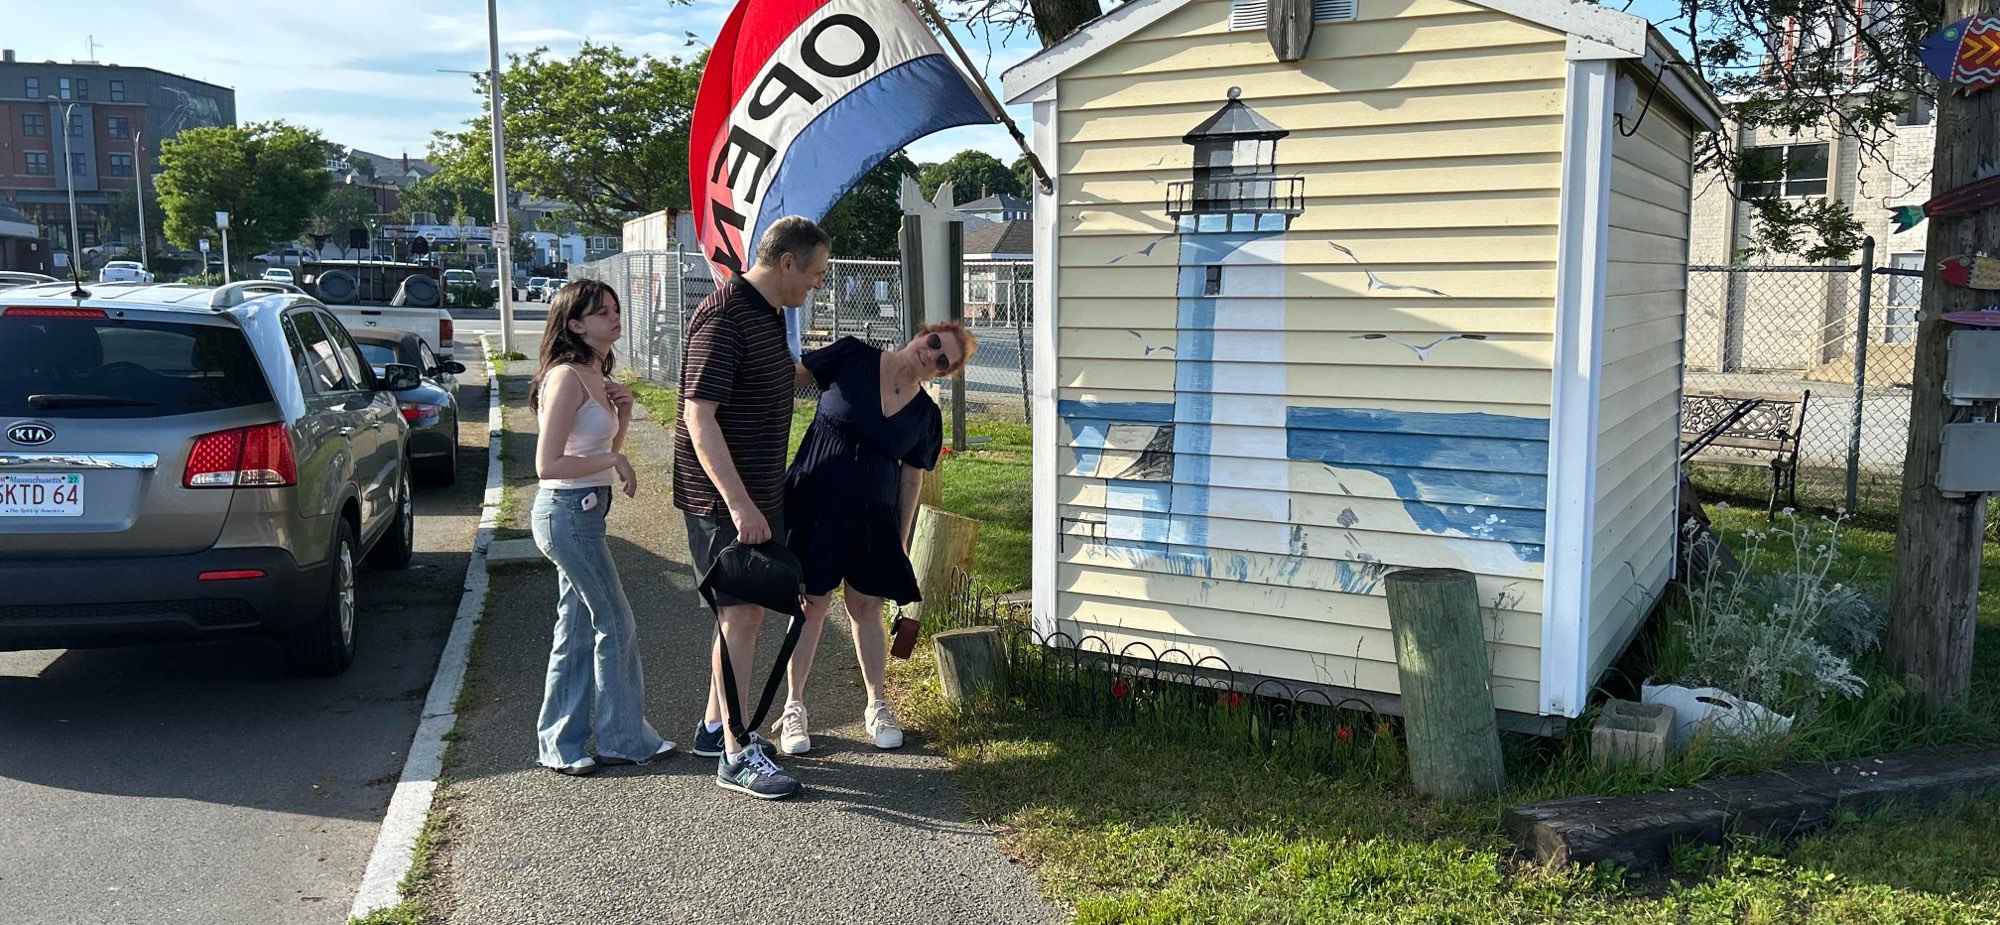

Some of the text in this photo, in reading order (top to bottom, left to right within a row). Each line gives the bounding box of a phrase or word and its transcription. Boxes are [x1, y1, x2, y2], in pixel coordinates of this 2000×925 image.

[15, 429, 47, 440] KIA
[10, 476, 62, 484] Massachusetts
[68, 476, 78, 484] 27
[0, 484, 78, 505] KTD 64
[735, 767, 758, 788] N
